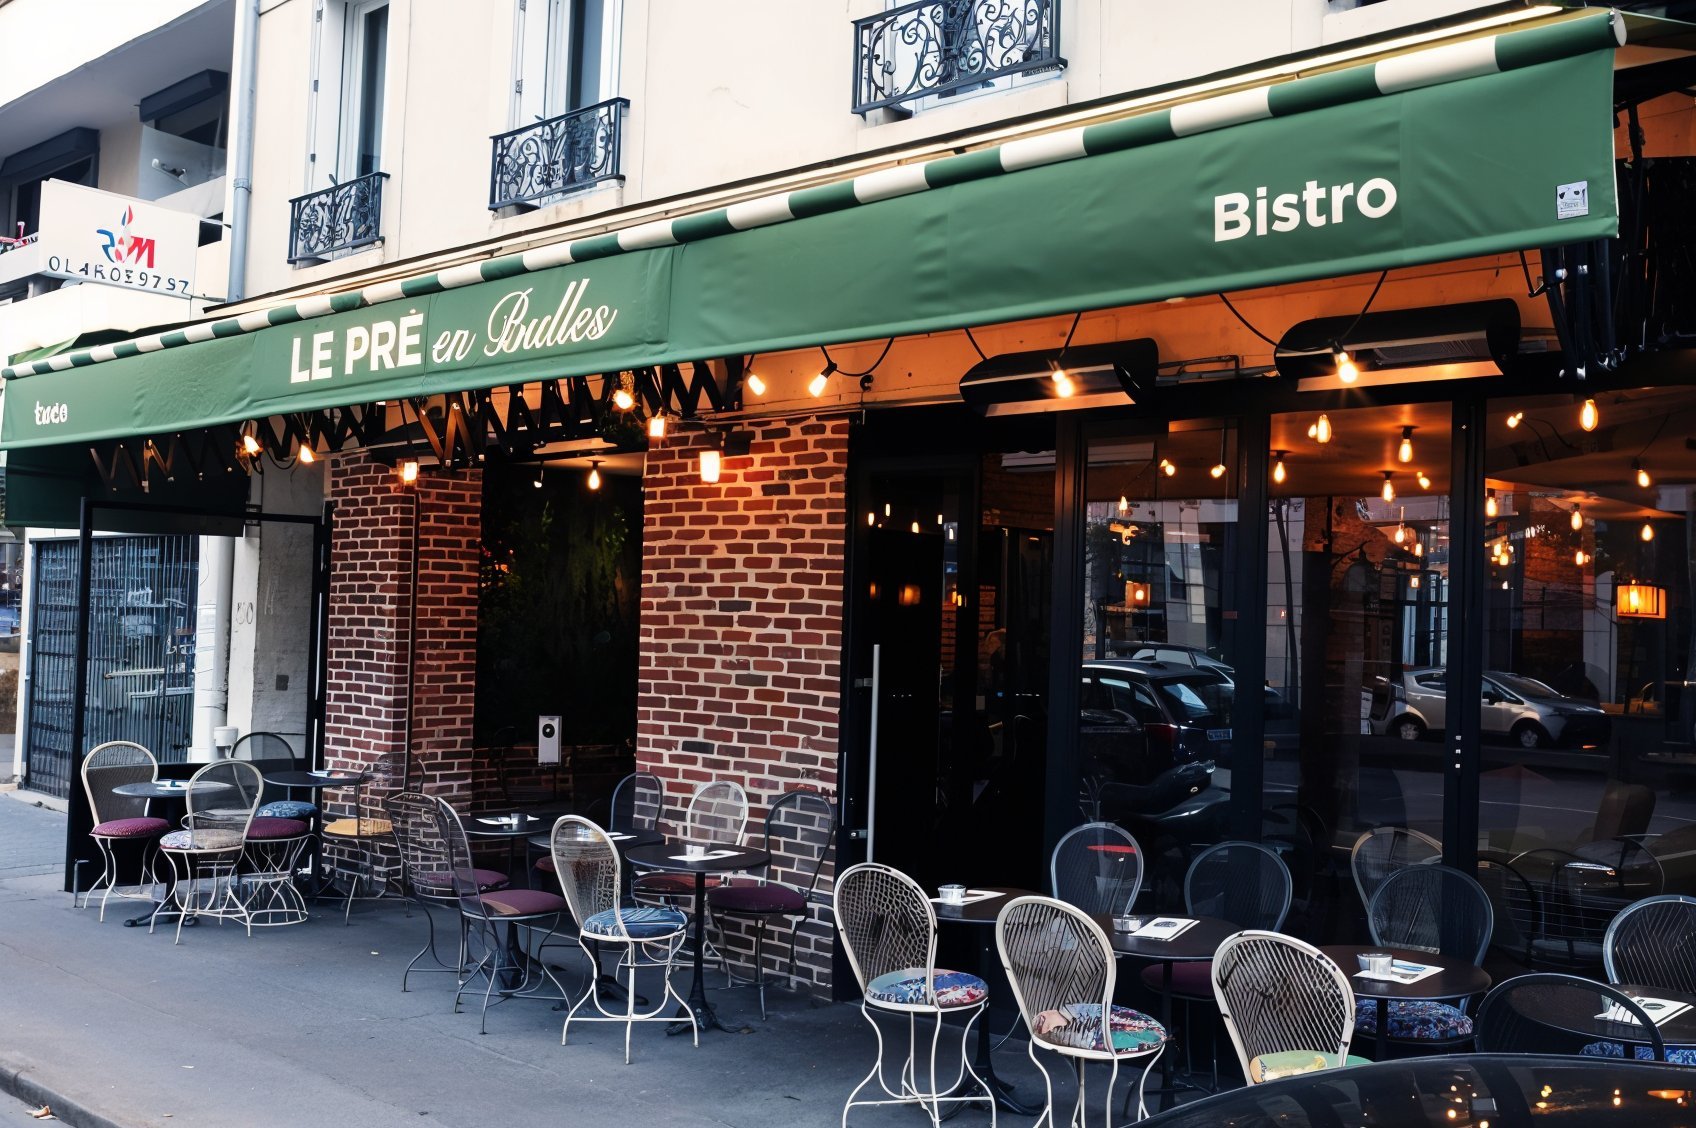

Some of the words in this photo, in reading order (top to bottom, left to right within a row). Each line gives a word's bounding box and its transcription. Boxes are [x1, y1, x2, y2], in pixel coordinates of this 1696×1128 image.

[1214, 177, 1398, 243] Bistro
[290, 330, 334, 383] LE
[432, 329, 476, 363] en
[484, 278, 617, 357] Bulles
